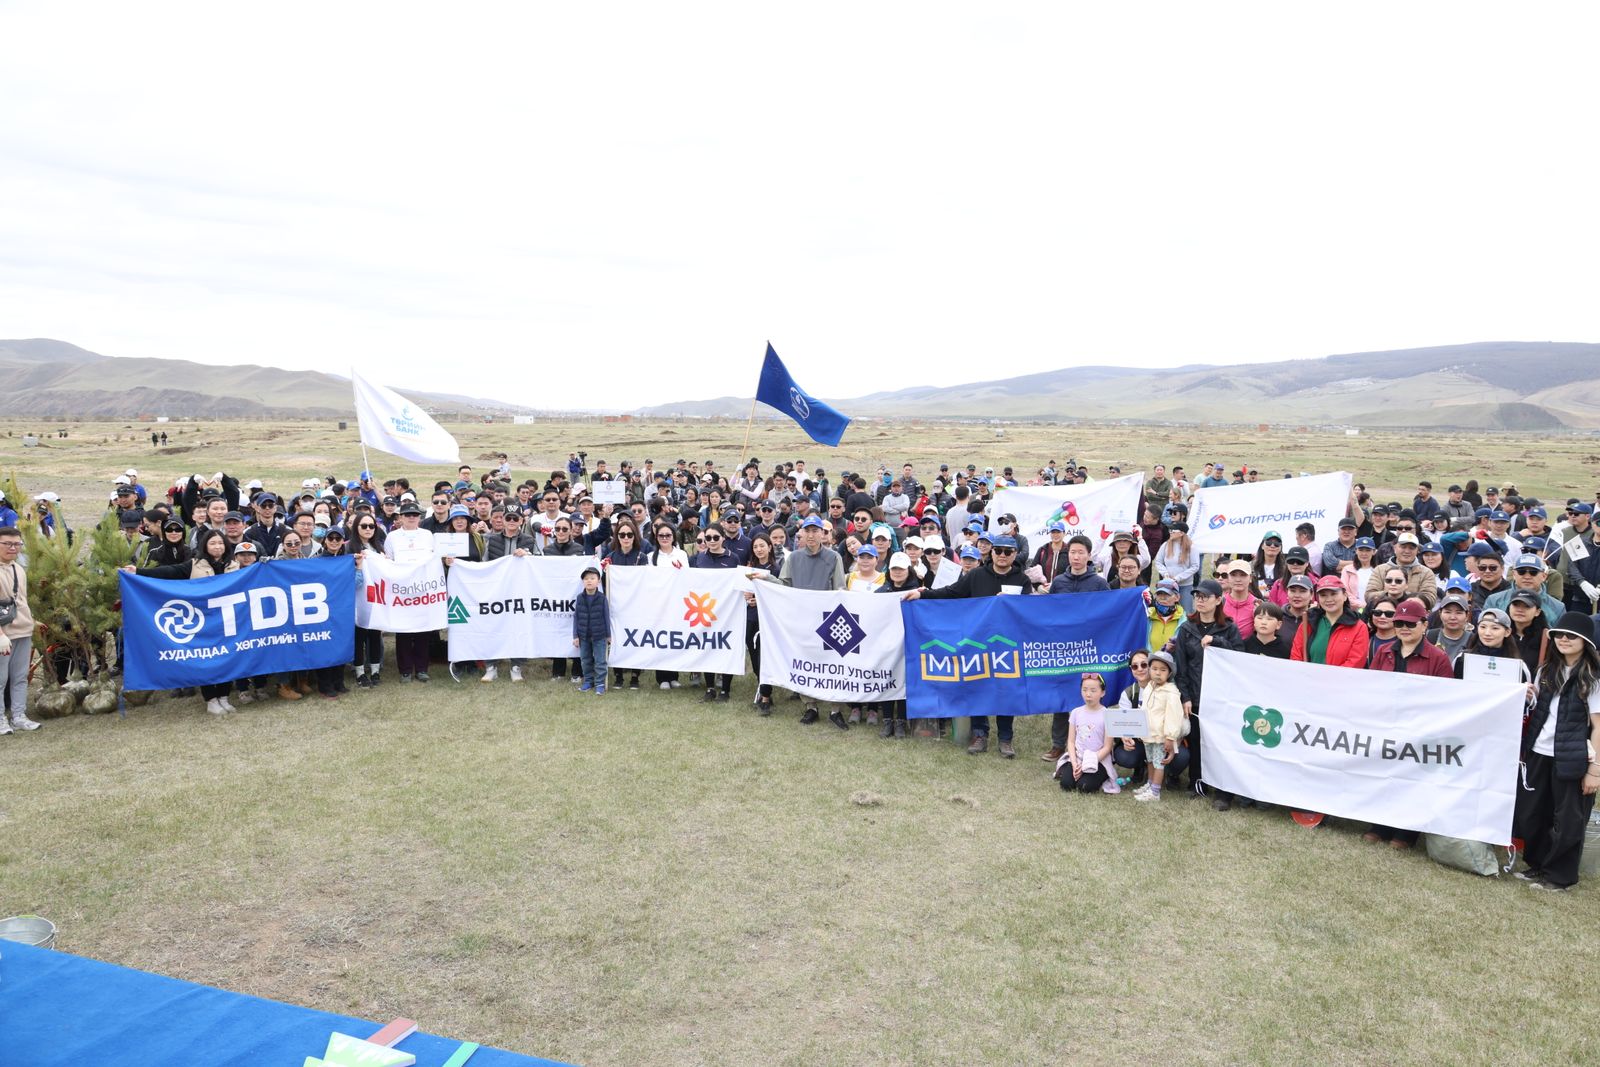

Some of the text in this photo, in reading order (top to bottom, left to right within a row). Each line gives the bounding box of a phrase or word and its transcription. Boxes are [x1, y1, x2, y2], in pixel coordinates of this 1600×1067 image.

[396, 425, 420, 436] БАНК
[1228, 509, 1326, 525] КАПИТРОН БАНК
[1066, 529, 1086, 537] АНК
[391, 578, 437, 595] Banking
[392, 590, 448, 608] Academ
[479, 598, 525, 615] БОГД
[530, 597, 576, 613] БАНК
[208, 582, 330, 637] TDB
[158, 630, 332, 662] ХУДАЛДАА ХӨГЖЛИЙН БАНК
[622, 628, 733, 650] ХАСБАНК
[1023, 639, 1094, 651] МОНГОЛЫН
[792, 658, 893, 680] МОНГОЛ УЛСЫН
[929, 651, 1011, 673] МИК
[1024, 655, 1099, 669] КОРПОРАЦИ
[1101, 651, 1132, 664] ОССК
[789, 672, 897, 694] ХӨГЖЛИЙН БАНК
[1291, 722, 1465, 767] ХААН БАНК
